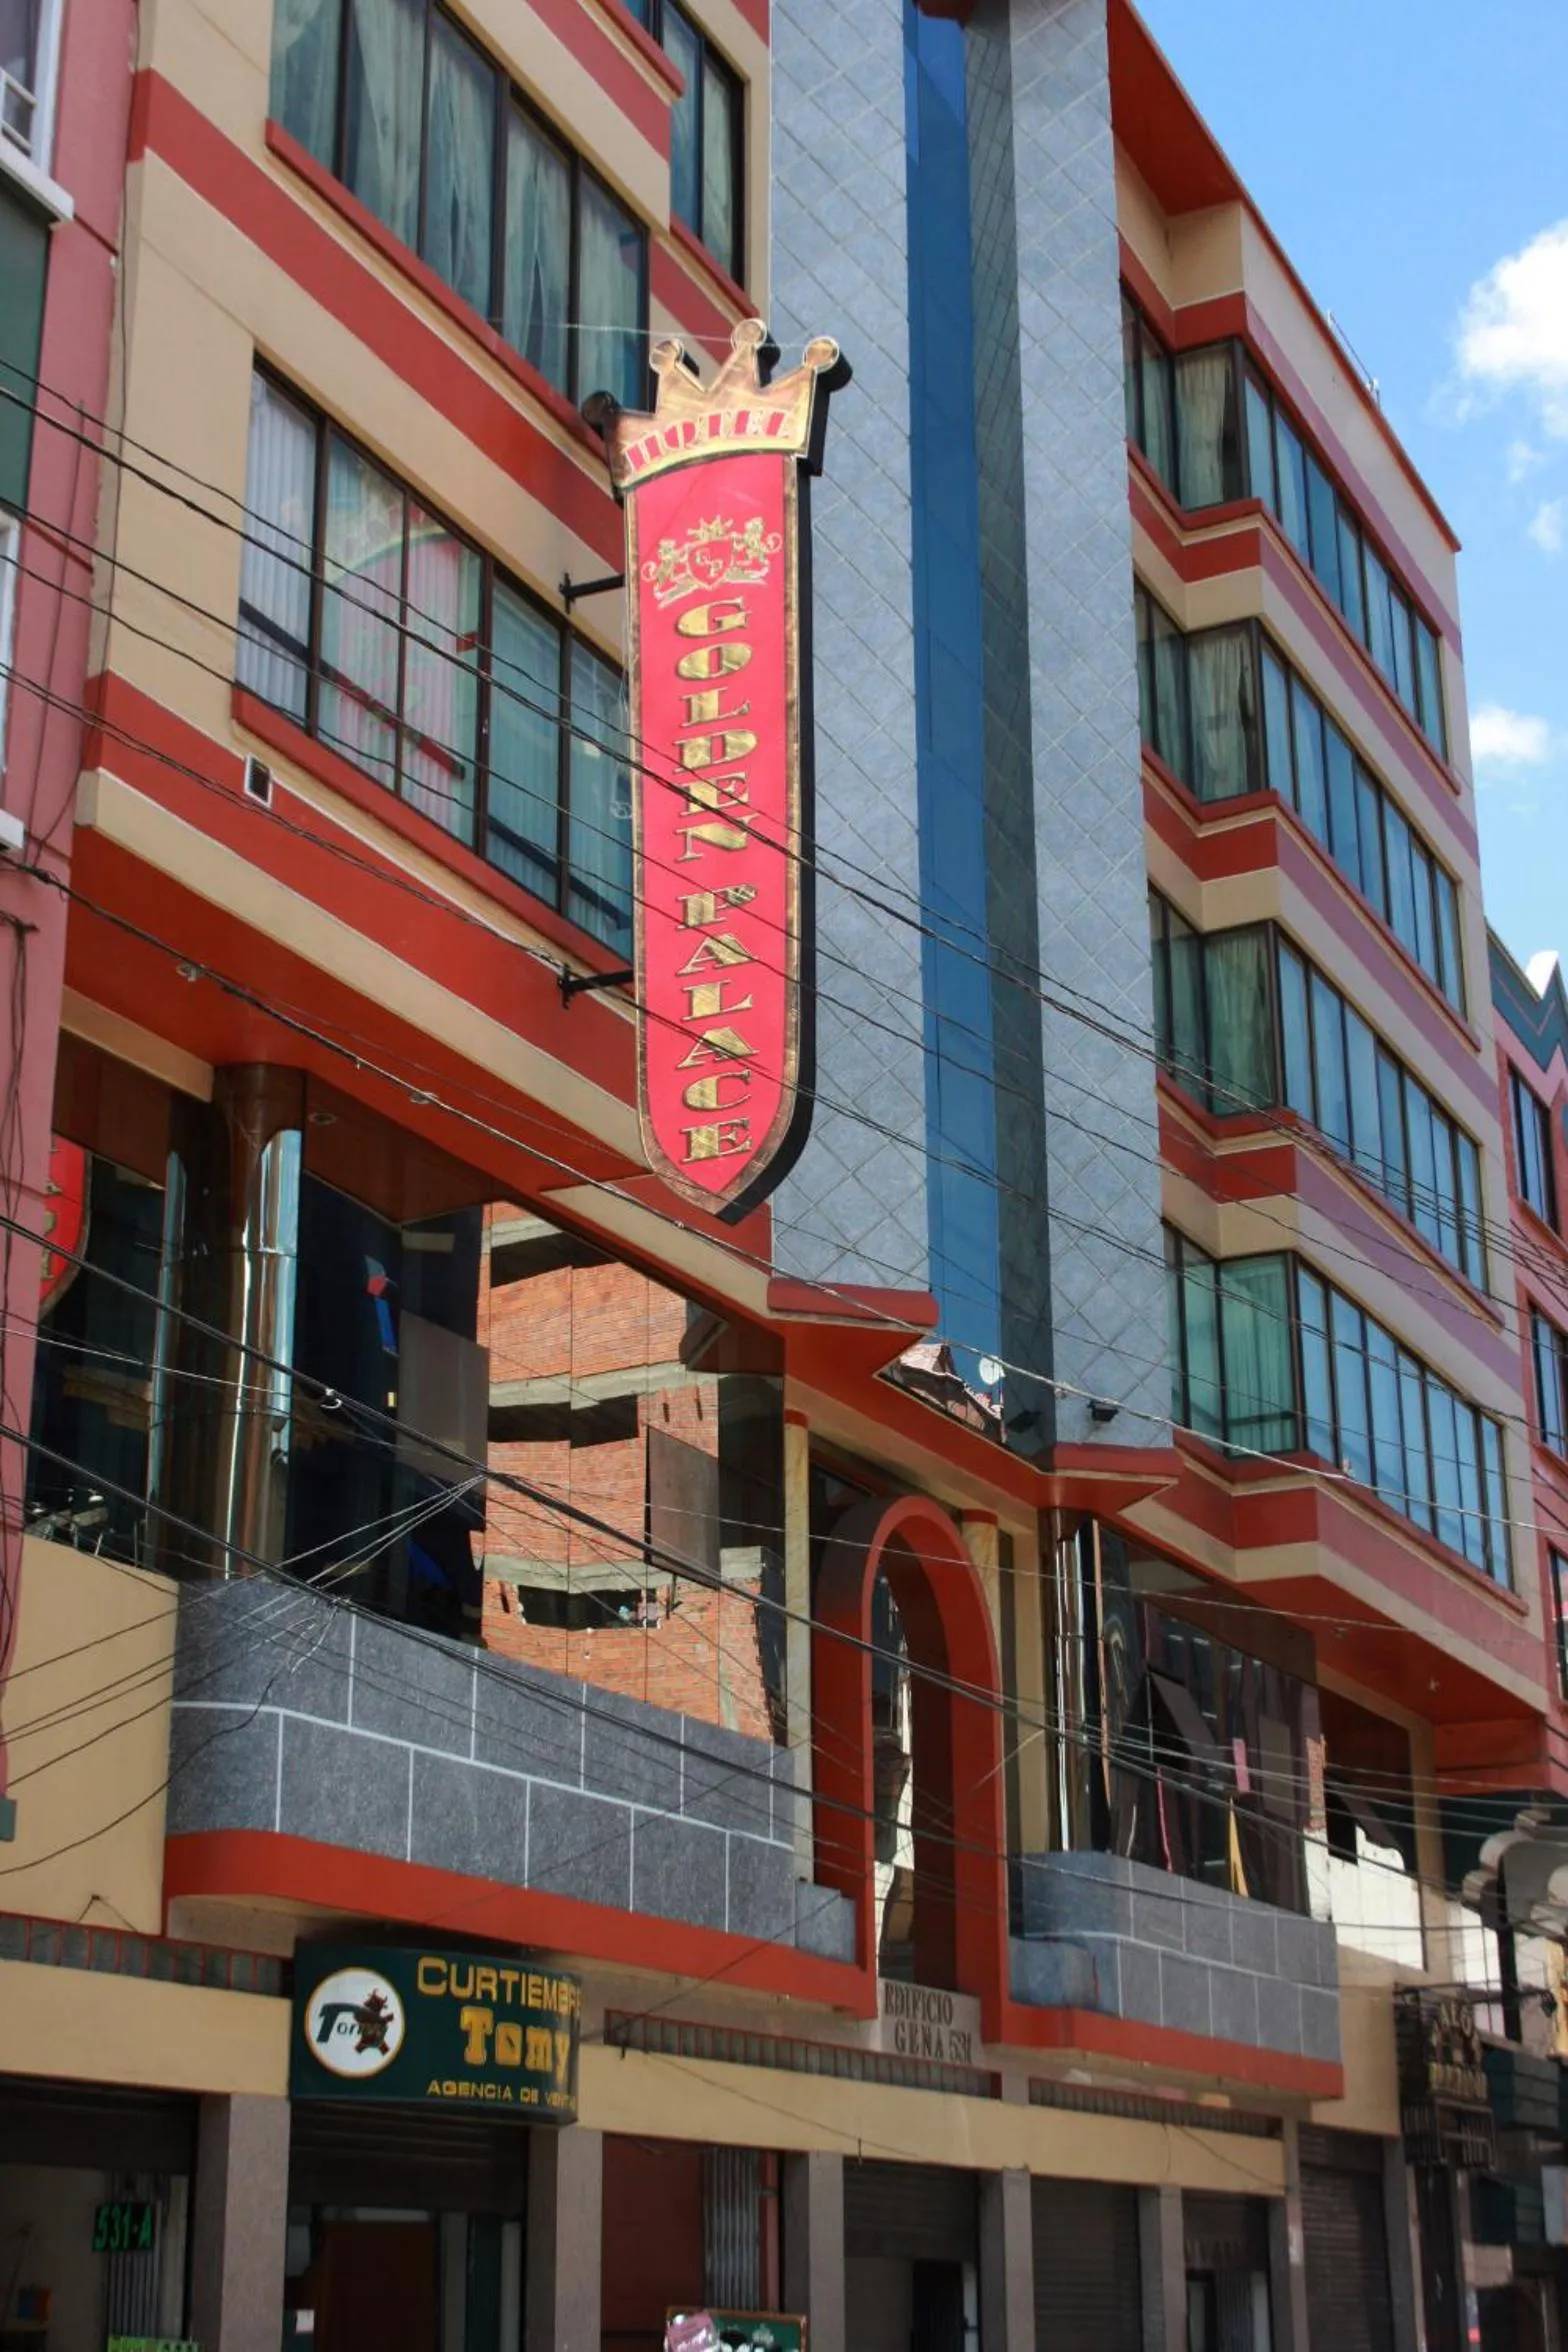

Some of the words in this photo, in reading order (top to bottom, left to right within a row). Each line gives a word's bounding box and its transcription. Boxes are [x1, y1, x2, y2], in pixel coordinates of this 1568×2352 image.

[623, 409, 792, 474] HOTEL
[673, 595, 761, 863] GOLDEN
[674, 884, 760, 1164] PALACE
[884, 1982, 954, 2027] EDIFICIO
[460, 2006, 570, 2084] Tomy
[426, 2079, 513, 2102] AGENCIA
[519, 2088, 539, 2105] DE
